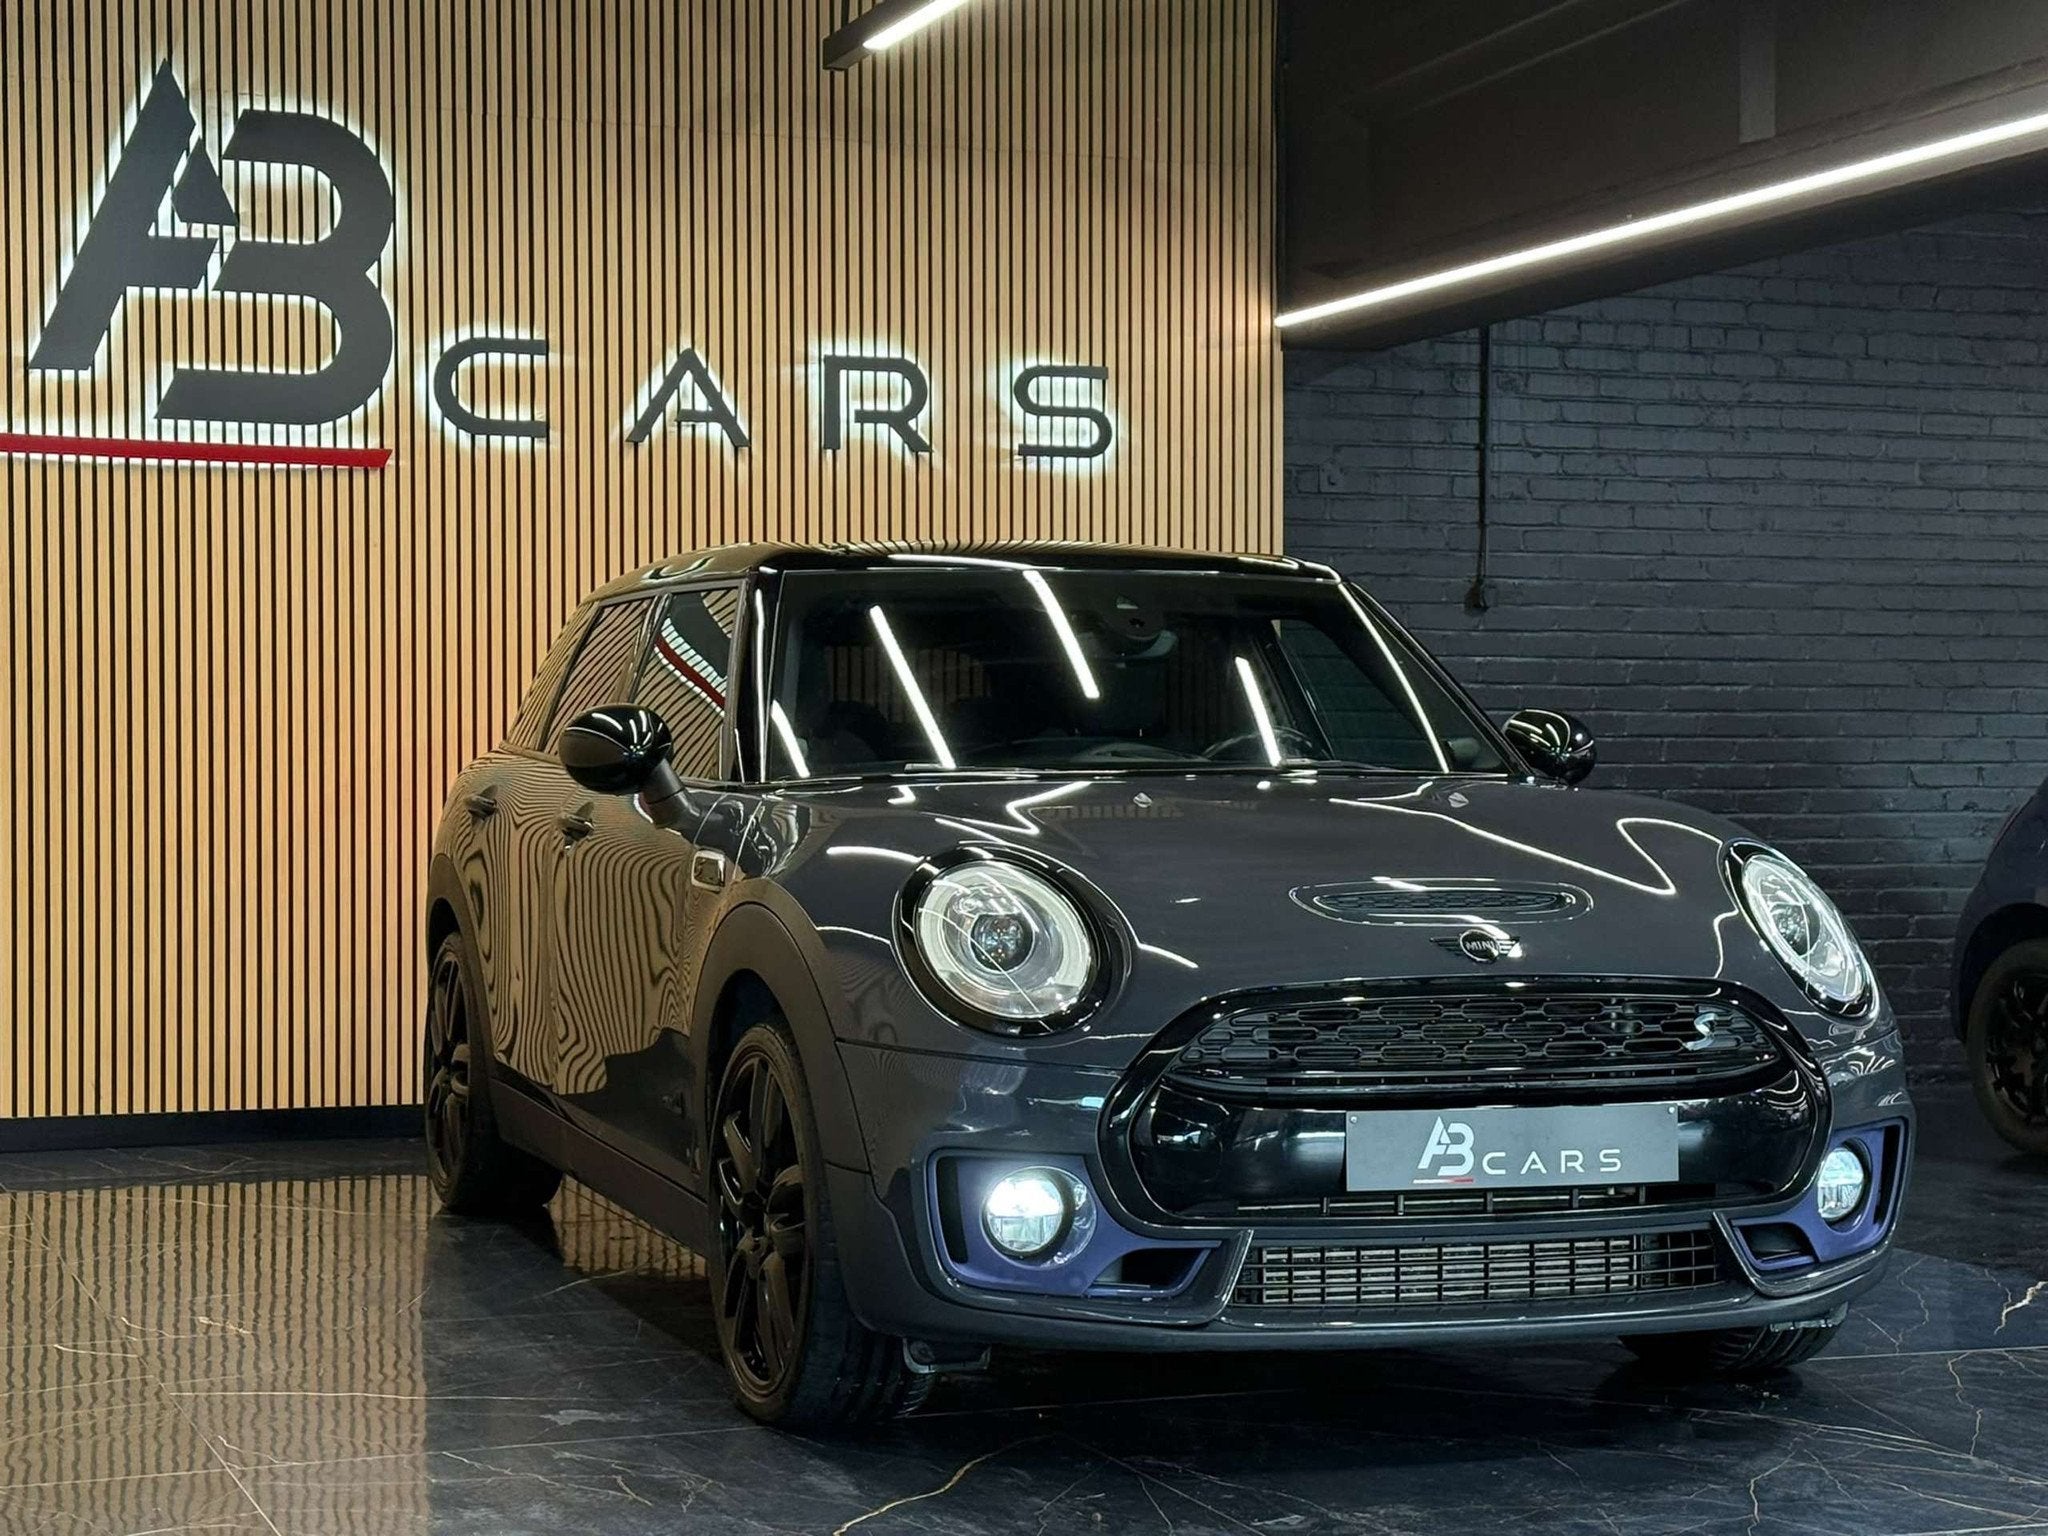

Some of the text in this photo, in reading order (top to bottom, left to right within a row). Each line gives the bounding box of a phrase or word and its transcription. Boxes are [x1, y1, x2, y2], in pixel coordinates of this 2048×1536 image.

[28, 58, 1113, 458] AB CARS
[1465, 940, 1495, 951] MINI
[1417, 1116, 1621, 1176] AB CARS
